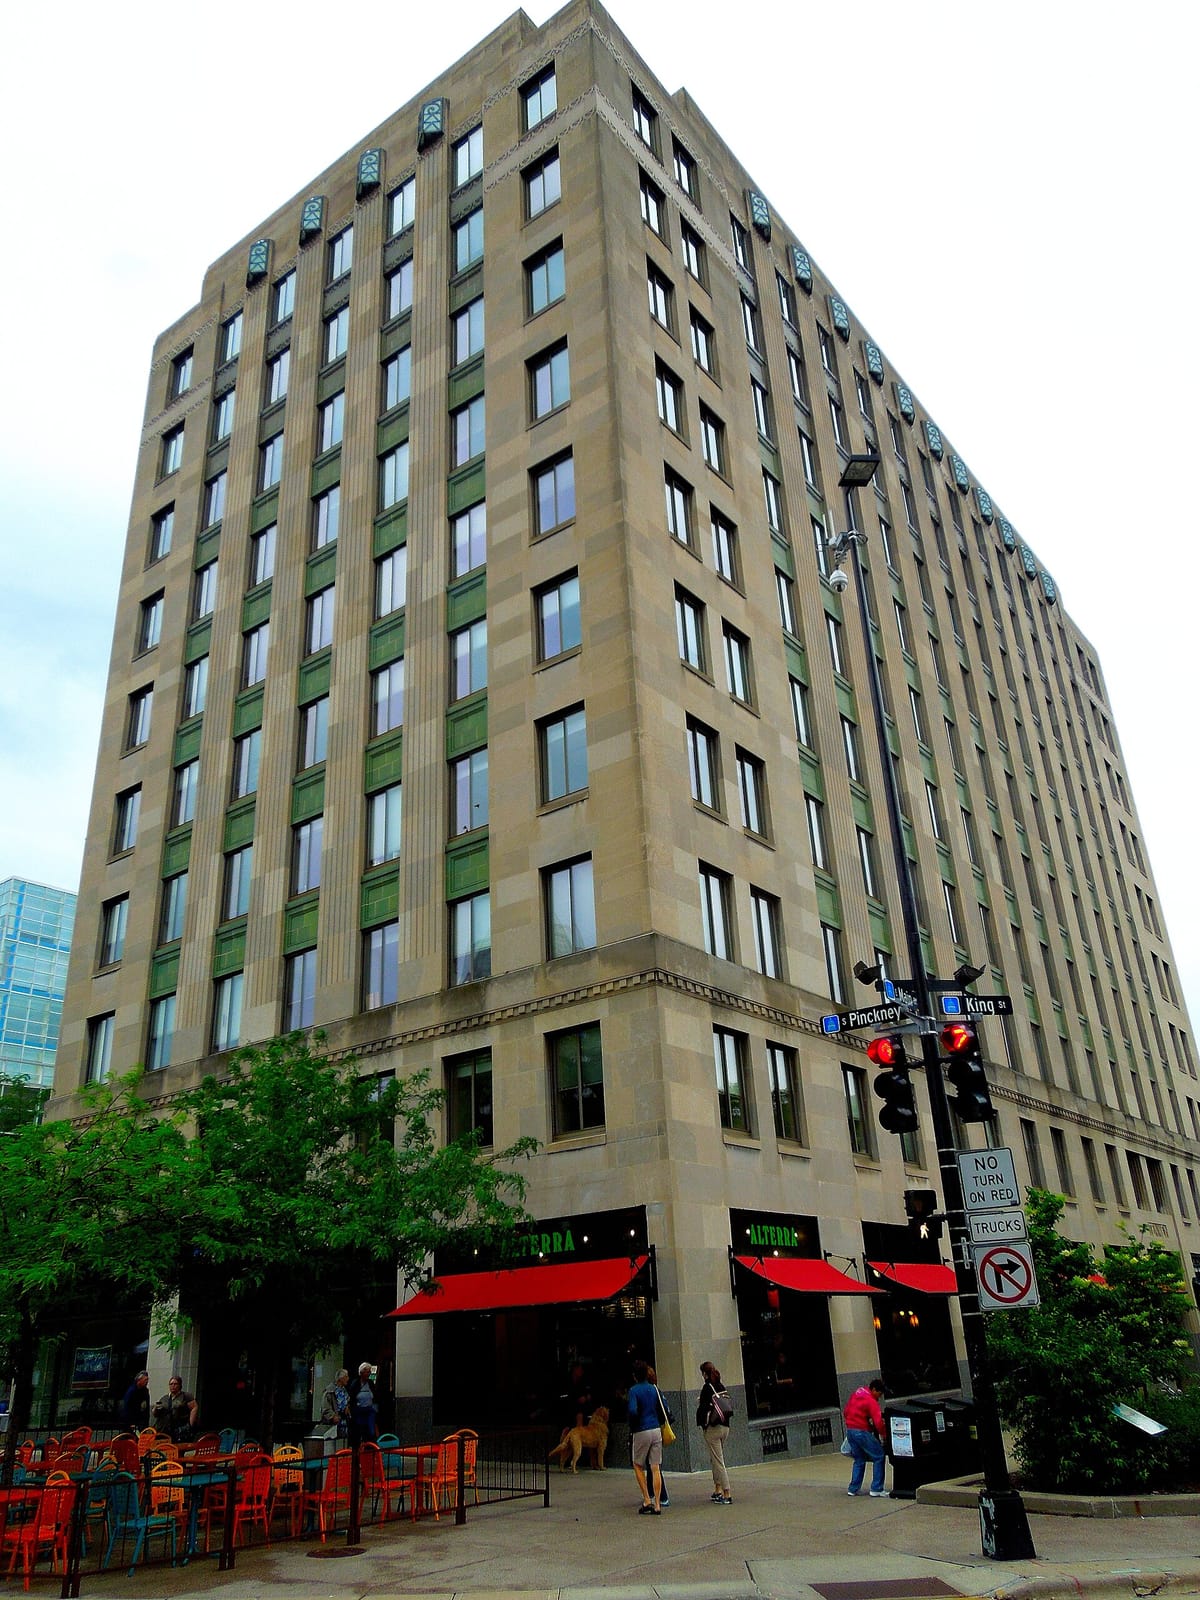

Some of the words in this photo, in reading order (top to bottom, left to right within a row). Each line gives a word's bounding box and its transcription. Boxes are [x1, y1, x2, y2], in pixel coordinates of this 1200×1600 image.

[965, 997, 995, 1016] King
[998, 1000, 1007, 1009] St
[848, 1006, 901, 1027] Pinckney
[974, 1156, 998, 1171] NO
[972, 1173, 1004, 1187] TURN
[969, 1191, 986, 1203] ON
[991, 1188, 1014, 1201] RED
[973, 1219, 1022, 1234] TRUCKS
[750, 1223, 798, 1247] ALTERRA
